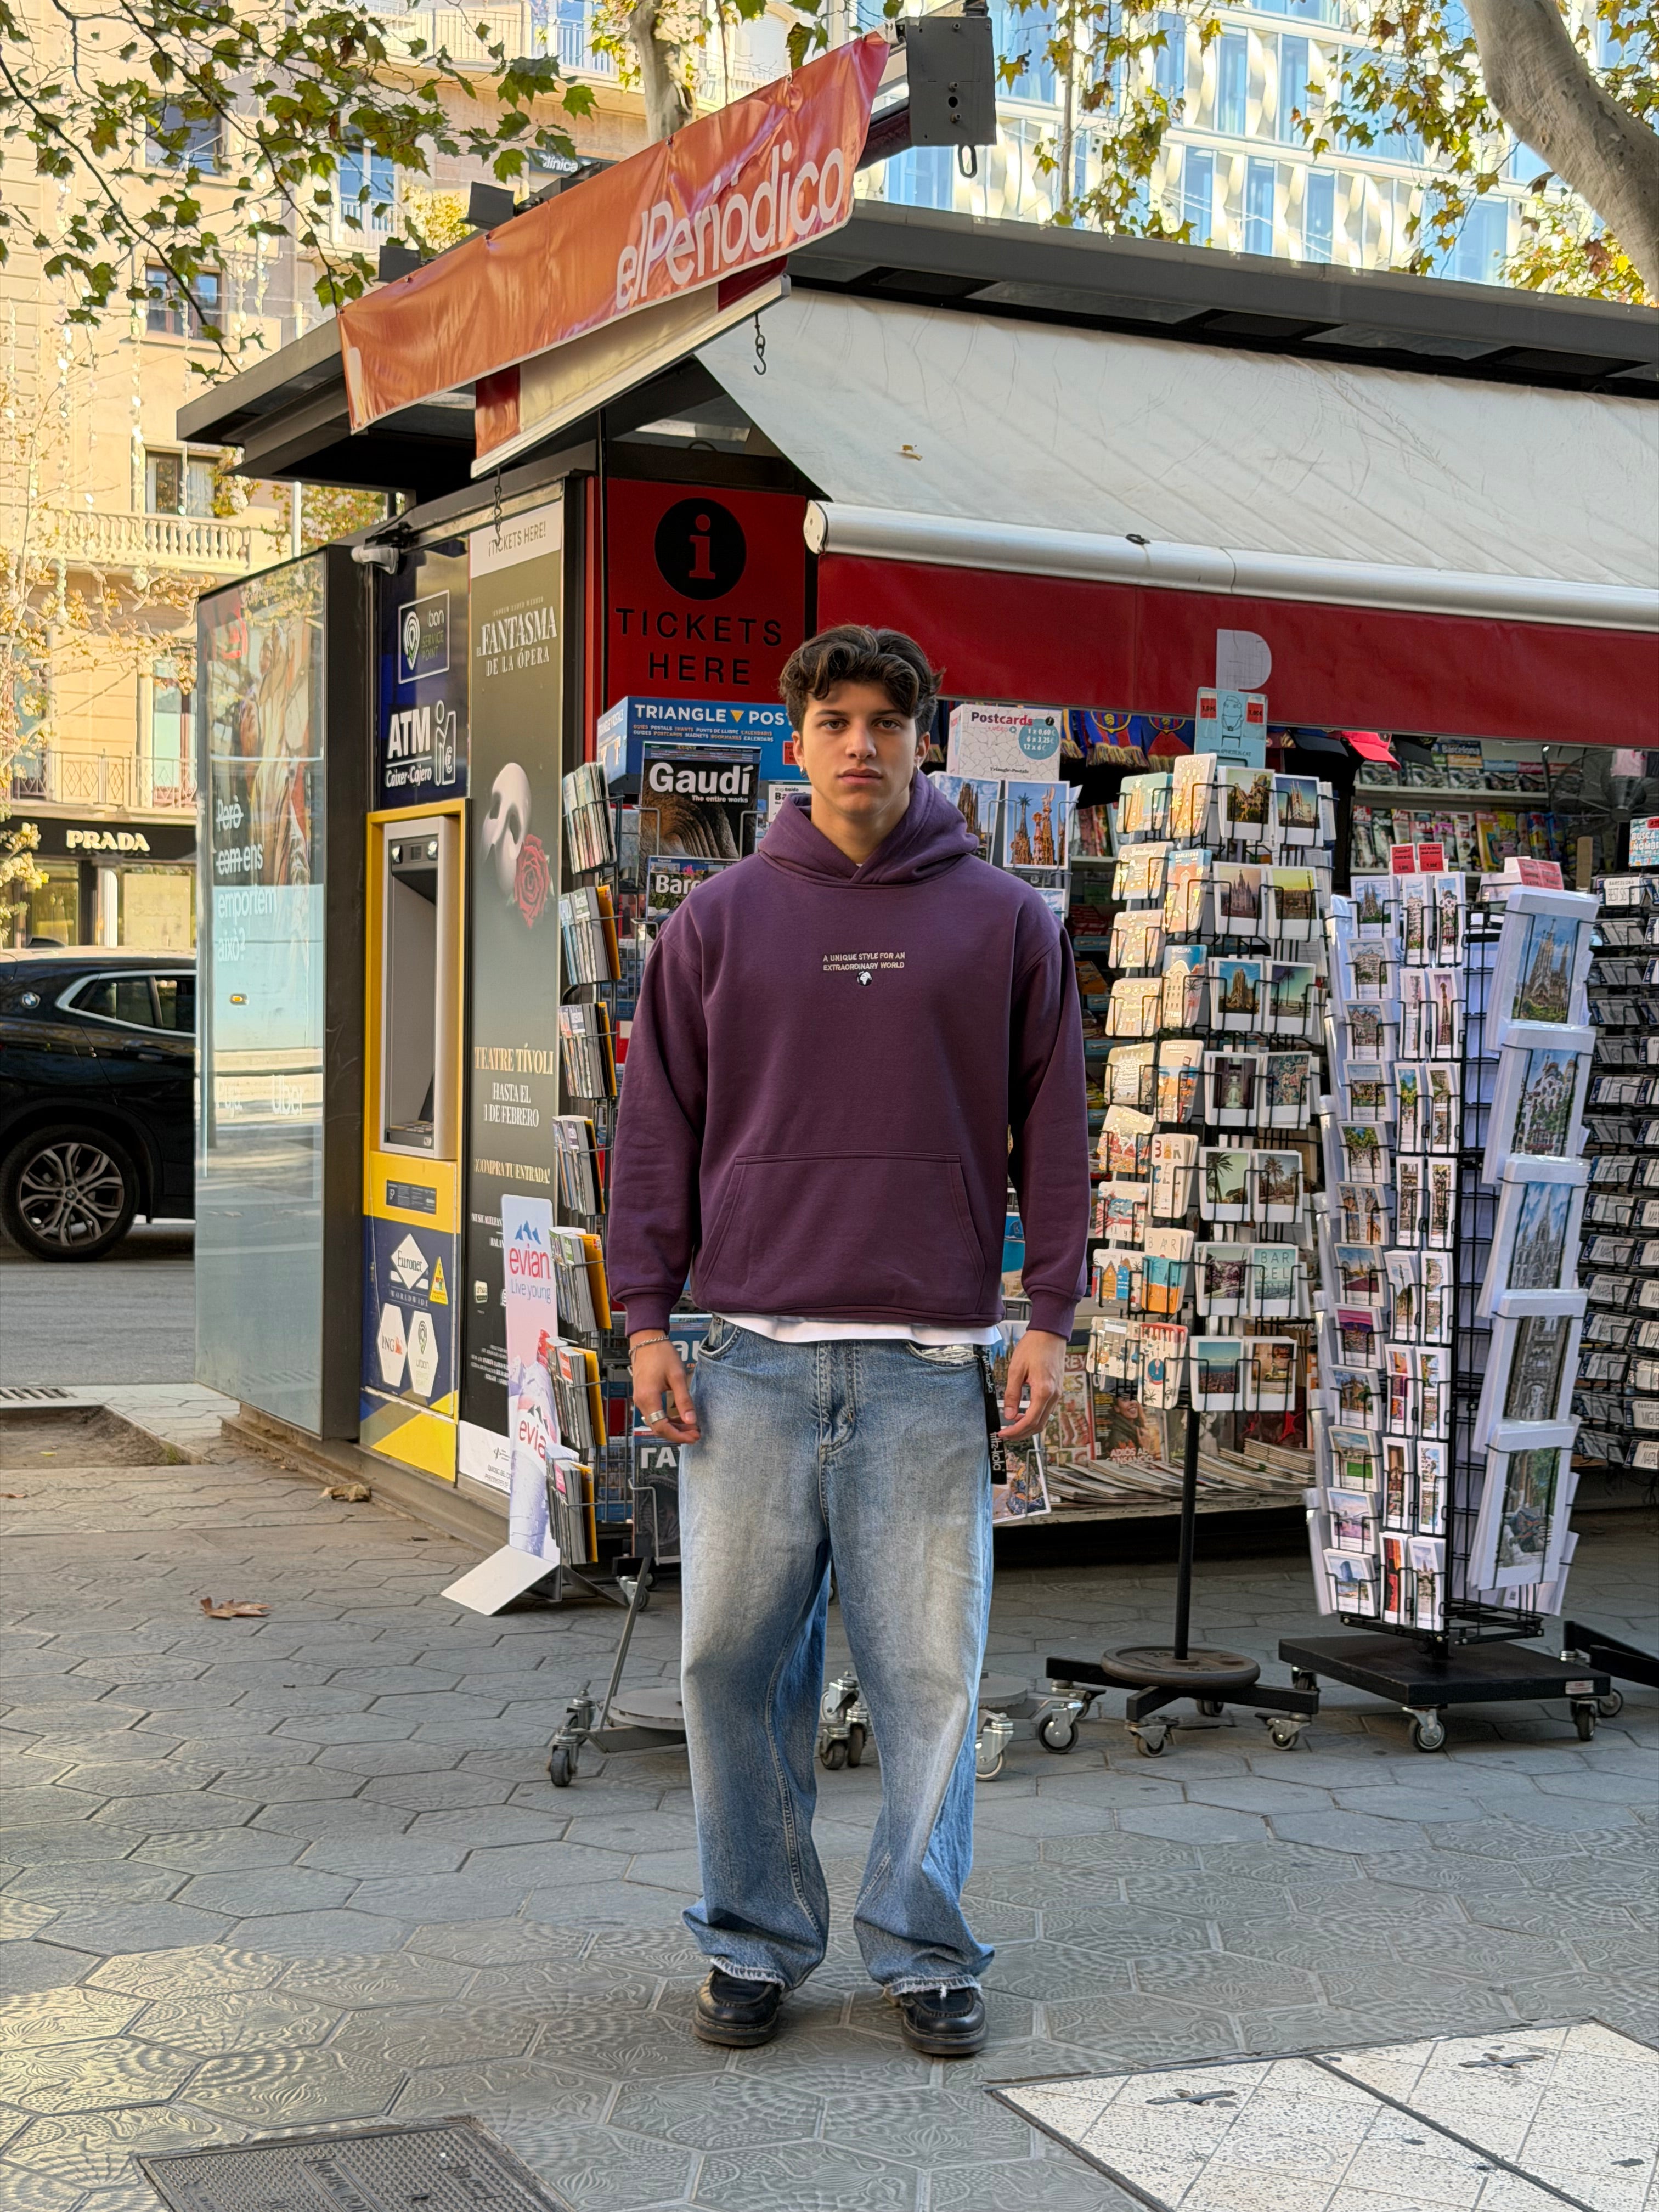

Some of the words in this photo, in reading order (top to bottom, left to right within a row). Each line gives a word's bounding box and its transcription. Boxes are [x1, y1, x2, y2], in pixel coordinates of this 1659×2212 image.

[524, 521, 546, 544] HERE!
[422, 630, 444, 648] SERVICE
[481, 606, 557, 656] FANTASMA
[616, 607, 782, 647] TICKETS
[422, 646, 438, 661] POINT
[486, 658, 499, 677] DE
[501, 655, 514, 673] LA
[517, 646, 550, 669] ÓPERA
[649, 652, 750, 685] HERE
[635, 704, 726, 723] TRIANGLE
[971, 712, 1033, 726] Postcards
[388, 706, 431, 760] ATM
[649, 762, 754, 795] Gaudí
[217, 795, 242, 832] Però
[66, 830, 150, 851] PRADA
[243, 843, 263, 872] ens
[218, 884, 278, 926] emportem
[217, 927, 245, 962] això?
[823, 962, 879, 971] EXTRAORDINARY
[830, 953, 857, 962] UNIQUE
[475, 1046, 514, 1072] TEATRE
[516, 1042, 554, 1075] TÍVOLI
[272, 1074, 304, 1115] Uber
[492, 1082, 519, 1102] HASTA
[521, 1085, 531, 1104] EL
[483, 1104, 488, 1122] 1
[489, 1105, 500, 1123] DE
[501, 1106, 539, 1128] FEBRERO
[505, 1162, 514, 1178] TU
[516, 1164, 550, 1184] ENTRADA!
[397, 1250, 422, 1273] Euronet
[509, 1243, 551, 1280] evian
[1261, 1251, 1289, 1263] BAR
[390, 1289, 428, 1307] WORLDWIDE
[511, 1279, 526, 1295] Live
[527, 1284, 551, 1305] young
[382, 1335, 394, 1353] ING
[989, 1431, 1005, 1471] fritz-kola
